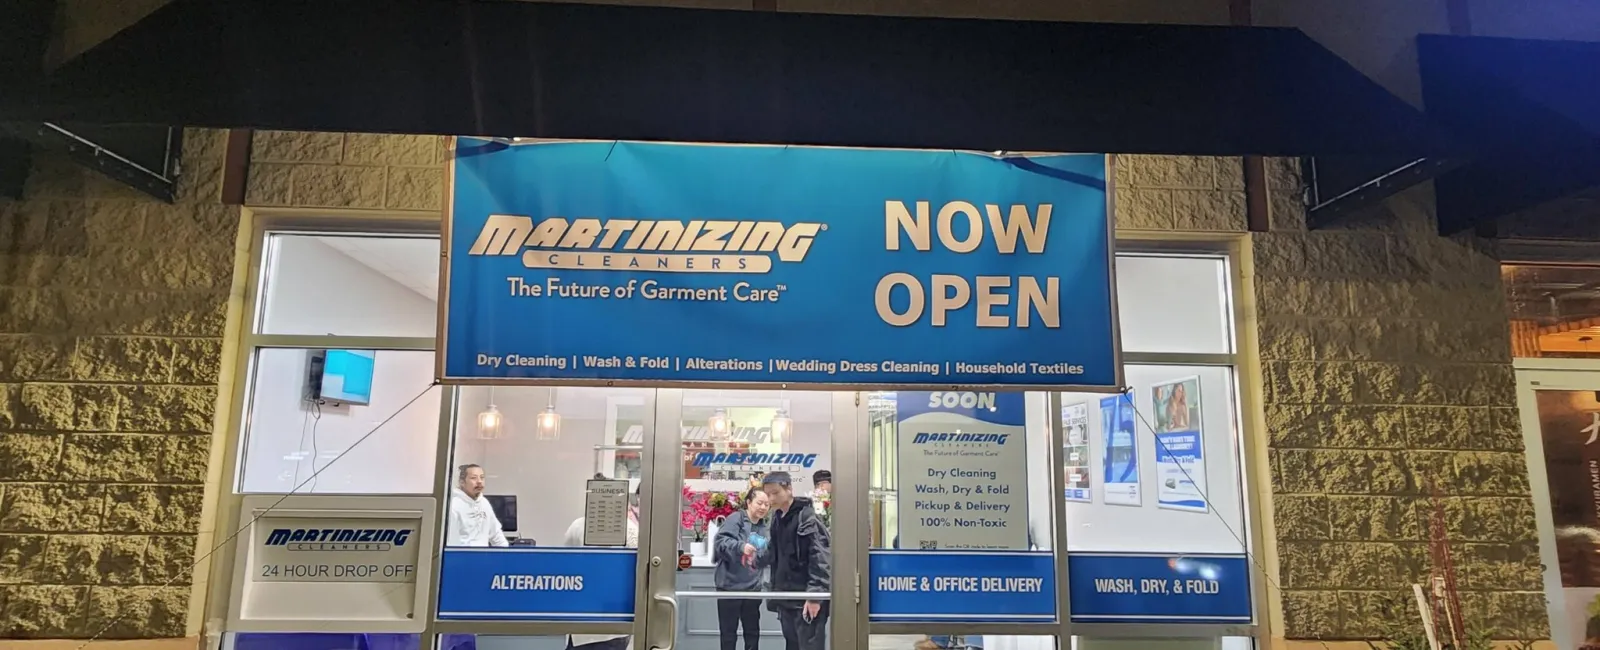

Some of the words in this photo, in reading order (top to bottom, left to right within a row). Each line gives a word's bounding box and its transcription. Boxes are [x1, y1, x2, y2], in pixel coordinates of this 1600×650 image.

[885, 200, 1053, 254] NOW
[548, 253, 747, 270] CLEANERS
[507, 277, 542, 297] The
[547, 277, 610, 299] Future
[615, 279, 636, 299] of
[640, 280, 728, 301] Garment
[874, 272, 1060, 328] OPEN
[477, 354, 502, 368] Dry
[505, 354, 567, 370] Cleaning
[583, 355, 621, 368] Wash
[625, 356, 636, 368] &
[640, 356, 669, 369] Fold
[686, 357, 763, 371] Alterations
[840, 360, 878, 373] Dress
[881, 361, 940, 376] Cleaning
[955, 361, 1026, 375] Household
[1030, 362, 1084, 375] Textiles
[928, 391, 996, 409] SOON
[928, 468, 947, 479] Dry
[950, 468, 997, 480] Cleaning
[915, 484, 949, 495] Wash,
[952, 485, 971, 496] Dry
[975, 484, 983, 494] &
[987, 485, 1009, 494] Fold
[915, 501, 950, 512] Pickup
[954, 501, 962, 510] &
[966, 501, 1010, 513] Delivery
[920, 517, 951, 527] 100%
[954, 518, 1007, 527] Non-Toxic
[264, 528, 413, 546] MARTINIZING
[262, 565, 279, 577] 24
[284, 565, 328, 577] HOUR
[334, 565, 378, 577] DROP
[383, 565, 413, 577] OFF
[491, 575, 583, 590] ALTERATIONS
[878, 576, 917, 591] HOME
[920, 576, 930, 592] &
[934, 577, 978, 592] OFFICE
[981, 577, 1043, 592] DELIVERY
[1095, 578, 1138, 595] WASH,
[1141, 579, 1170, 595] DRY,
[1173, 579, 1183, 593] &
[1186, 579, 1219, 594] FOLD
